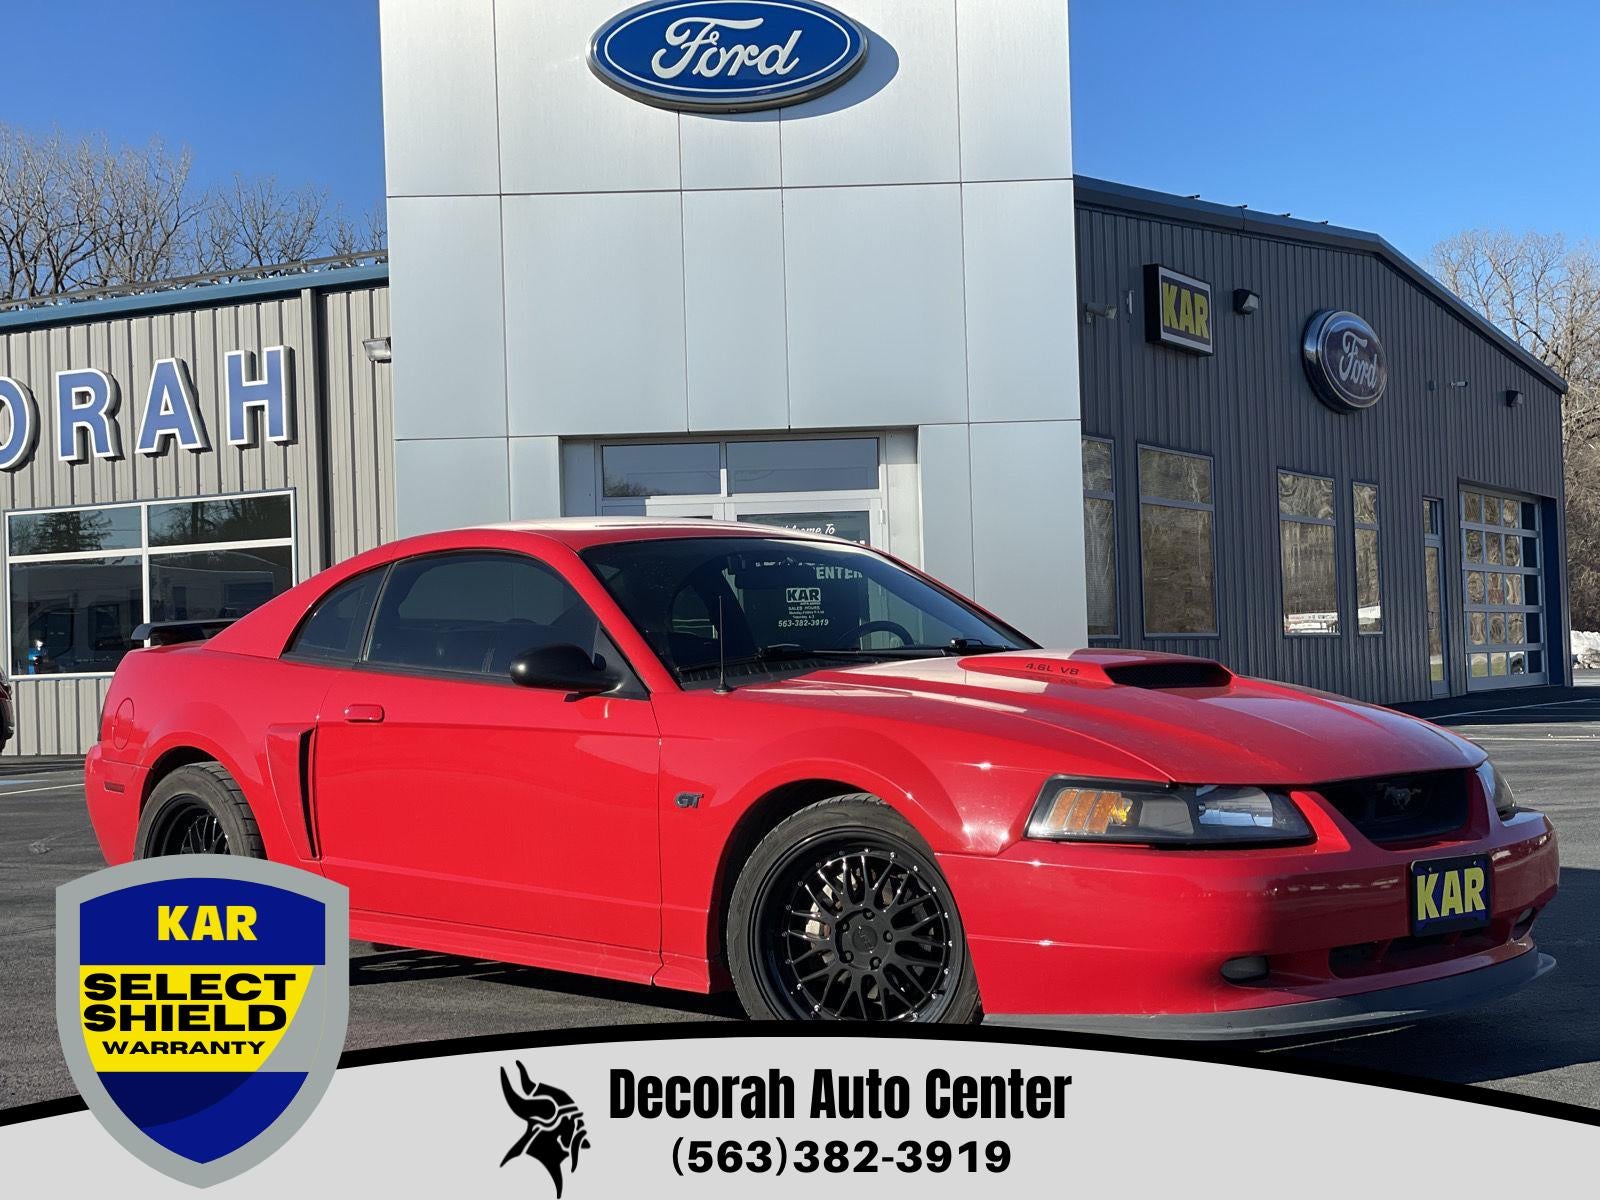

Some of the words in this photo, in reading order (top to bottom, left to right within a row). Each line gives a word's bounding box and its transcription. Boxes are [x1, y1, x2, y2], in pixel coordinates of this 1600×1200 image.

[651, 17, 803, 79] Ford
[1161, 281, 1210, 340] KAR
[1338, 331, 1378, 389] Ford
[786, 588, 821, 602] KAR
[778, 618, 829, 627] 563-382-3919
[1025, 663, 1053, 672] 4.6L
[1060, 666, 1080, 675] V8
[675, 792, 704, 808] GT
[1416, 866, 1487, 921] KAR
